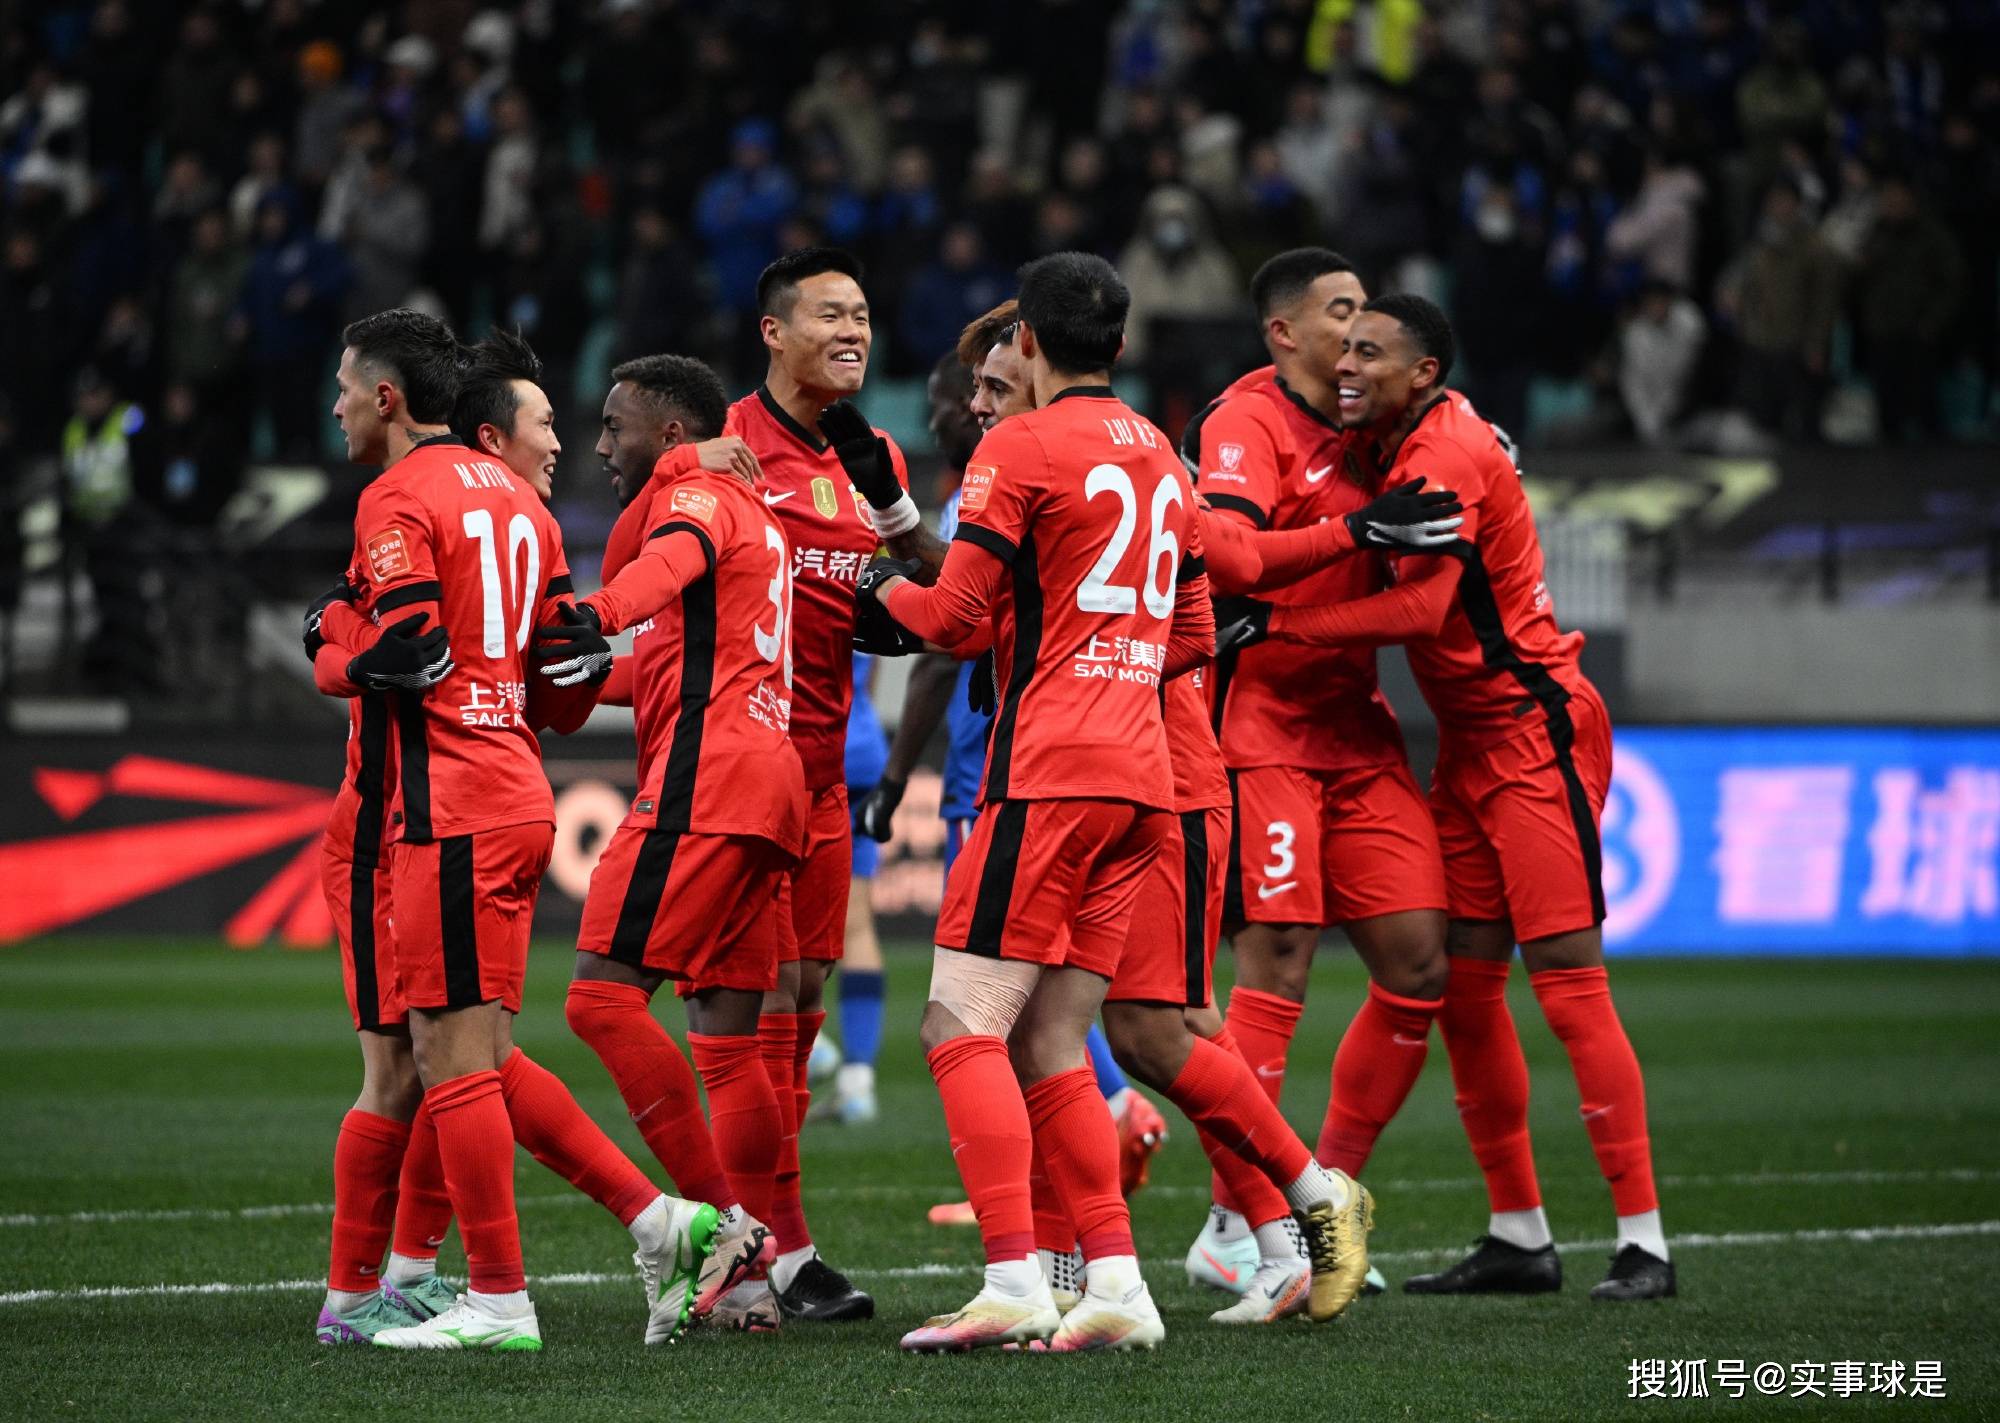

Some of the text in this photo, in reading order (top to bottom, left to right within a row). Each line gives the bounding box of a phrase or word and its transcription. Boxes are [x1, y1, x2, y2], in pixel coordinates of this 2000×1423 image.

[1103, 418, 1134, 445] LIU
[1077, 464, 1183, 619] 26
[463, 509, 539, 659] 10
[462, 712, 511, 727] SAIC
[1263, 821, 1295, 879] 3
